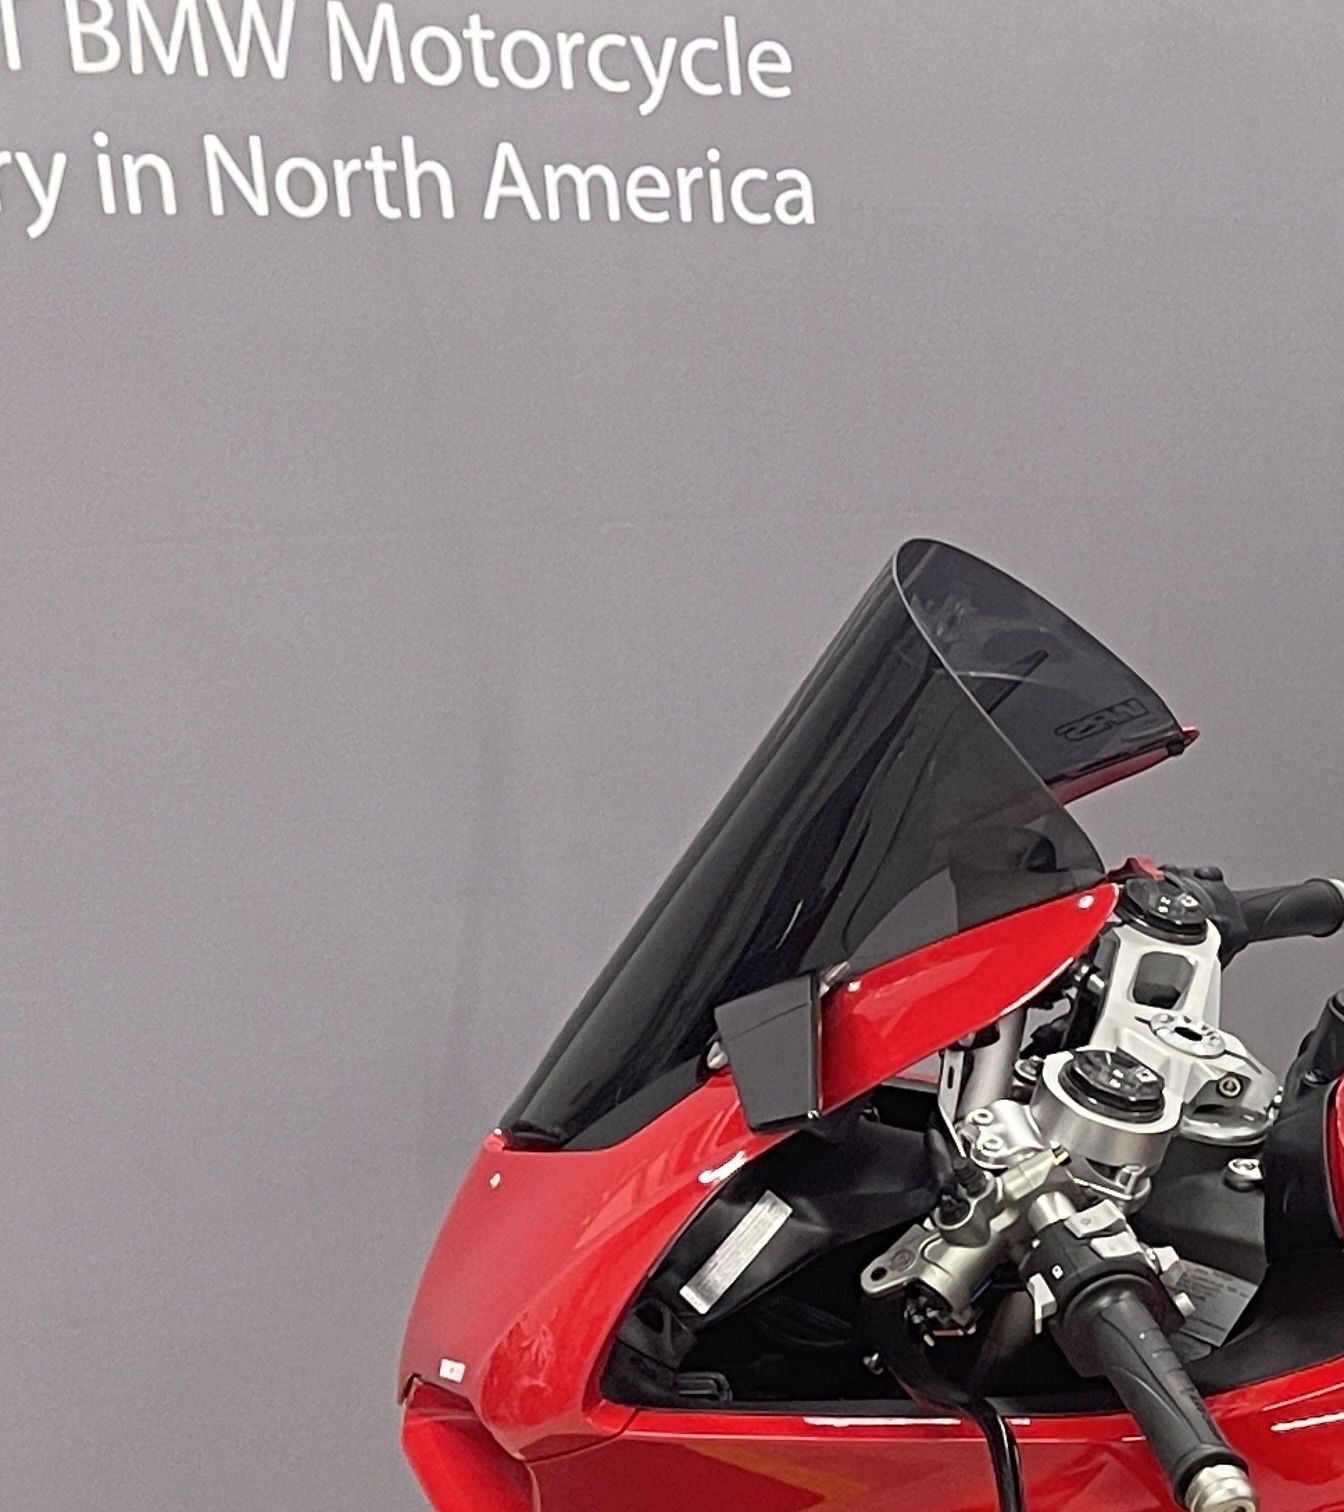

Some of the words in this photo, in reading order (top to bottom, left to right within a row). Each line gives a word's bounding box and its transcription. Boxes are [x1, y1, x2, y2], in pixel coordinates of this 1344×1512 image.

[65, 0, 295, 79] BMW
[327, 0, 793, 116] Motorcycle
[93, 131, 177, 215] in
[203, 134, 455, 219] North
[484, 142, 816, 225] America
